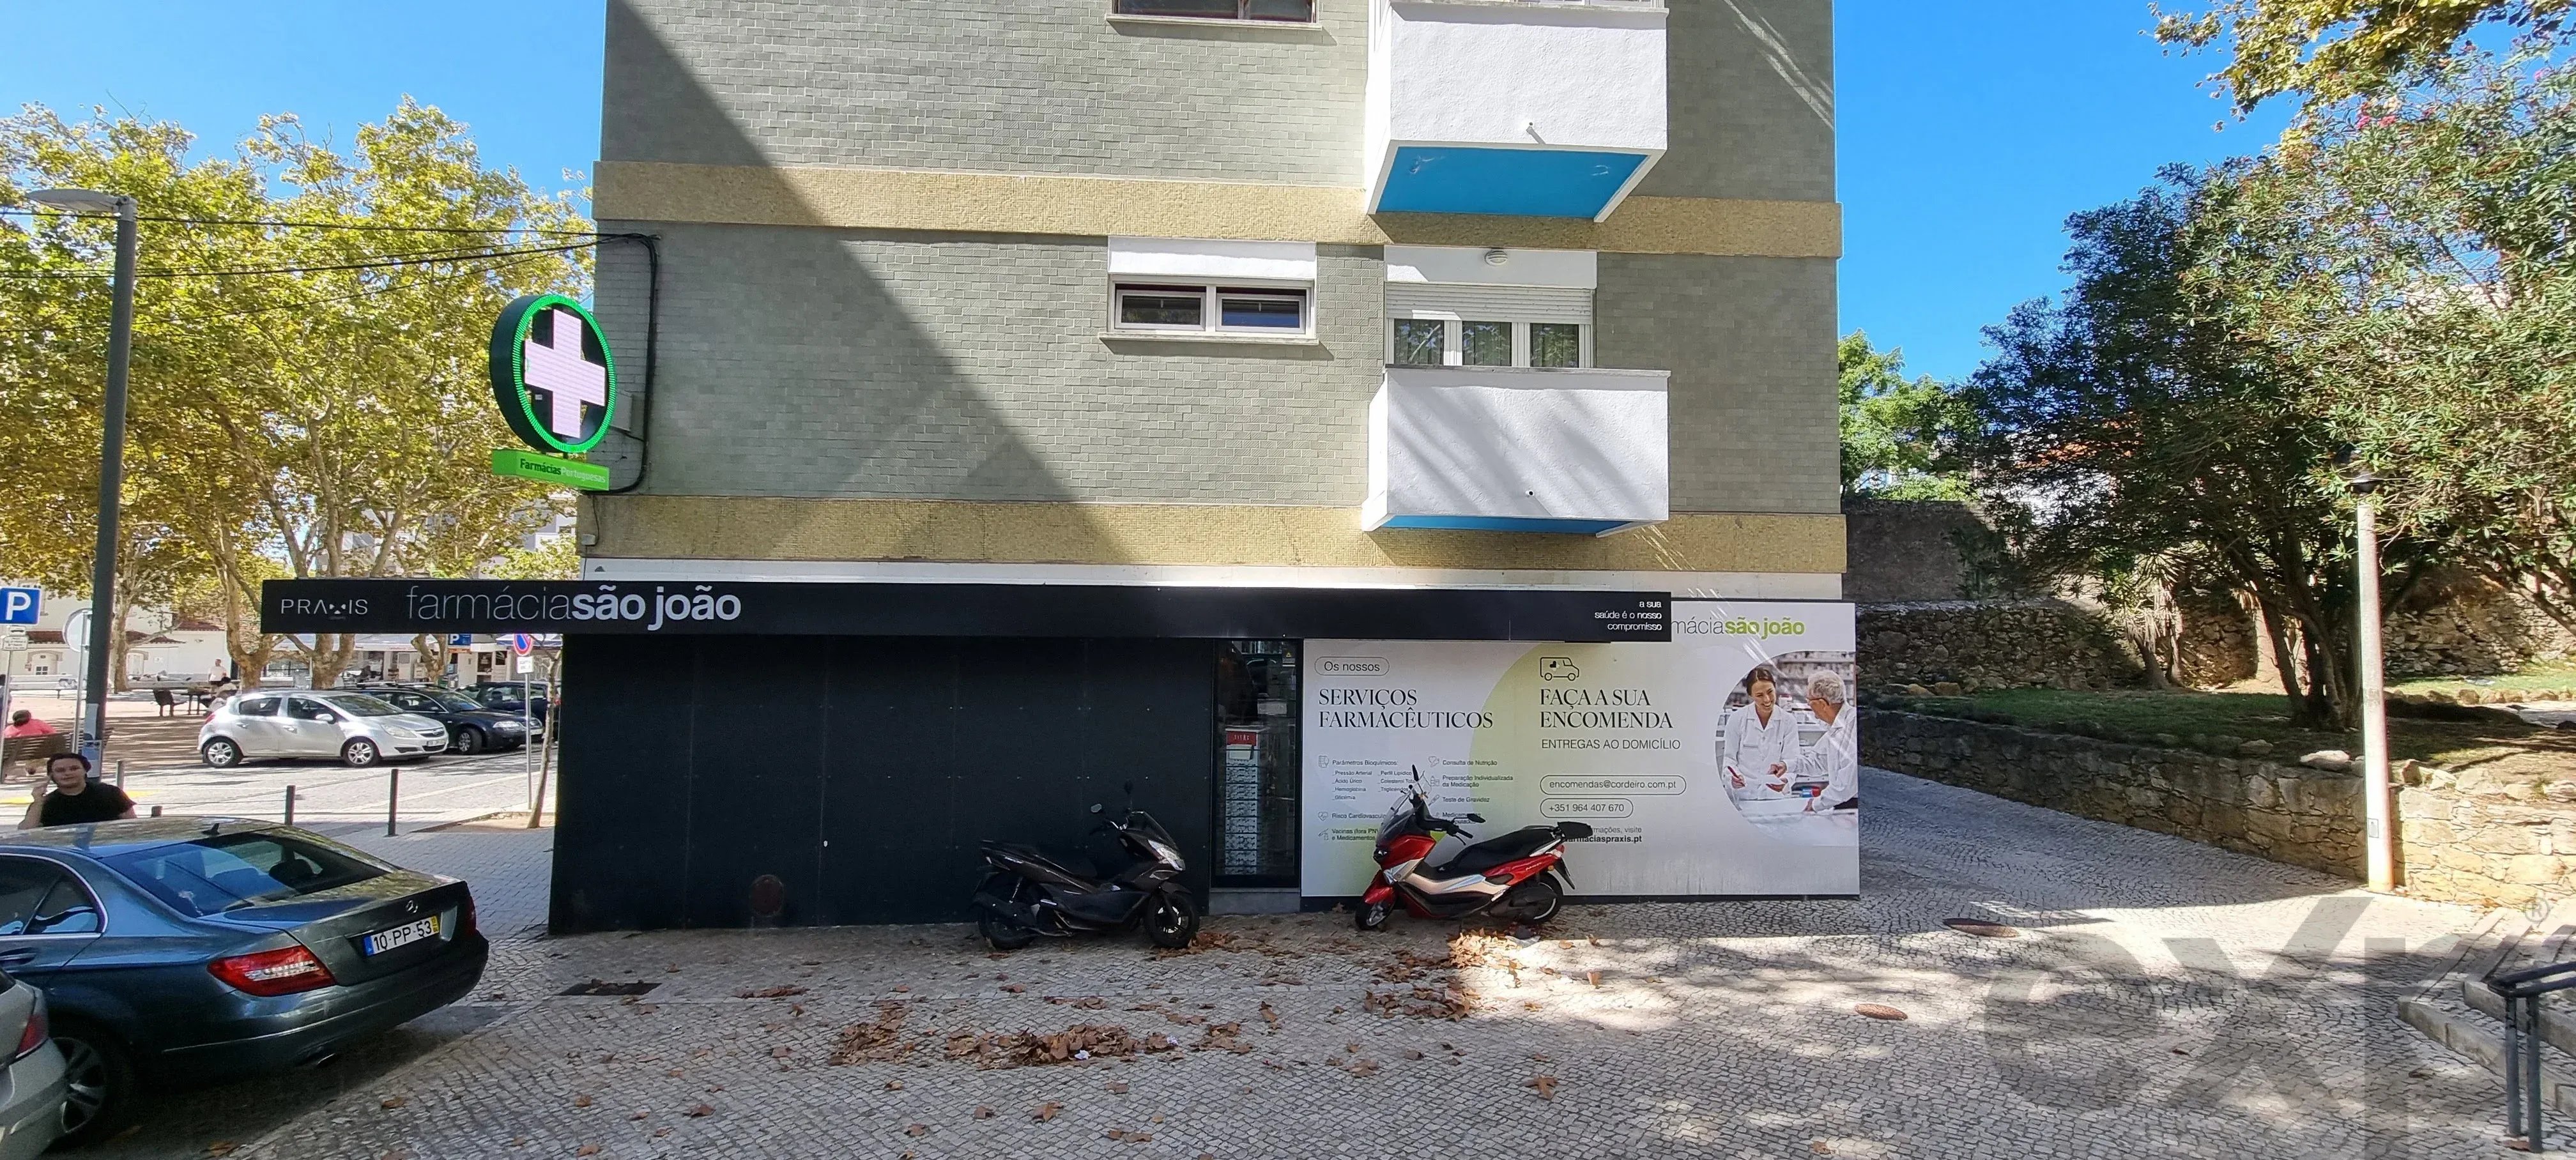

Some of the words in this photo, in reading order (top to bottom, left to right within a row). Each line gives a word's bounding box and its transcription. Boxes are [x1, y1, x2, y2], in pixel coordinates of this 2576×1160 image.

[5, 591, 31, 620] P
[647, 585, 741, 631] joão
[1595, 610, 1620, 619] saúde
[1622, 610, 1627, 619] é
[1607, 622, 1662, 632] compromisso
[1761, 616, 1805, 639] joão
[450, 634, 460, 644] P
[1324, 661, 1339, 672] Os
[1342, 662, 1380, 672] nossos
[1318, 688, 1417, 709] SERVIÇOS
[1540, 689, 1591, 710] FAÇA
[1594, 689, 1608, 706] A
[1612, 689, 1651, 706] SUA
[1318, 708, 1493, 729] FARMACÊUTICOS
[1540, 711, 1673, 728] ENCOMENDA
[1542, 739, 1600, 749] ENTREGAS
[1603, 739, 1620, 749] AO
[1622, 736, 1681, 750] DOMICÍLIO
[1549, 780, 1676, 790] encomendas@cordeiro.com.pt
